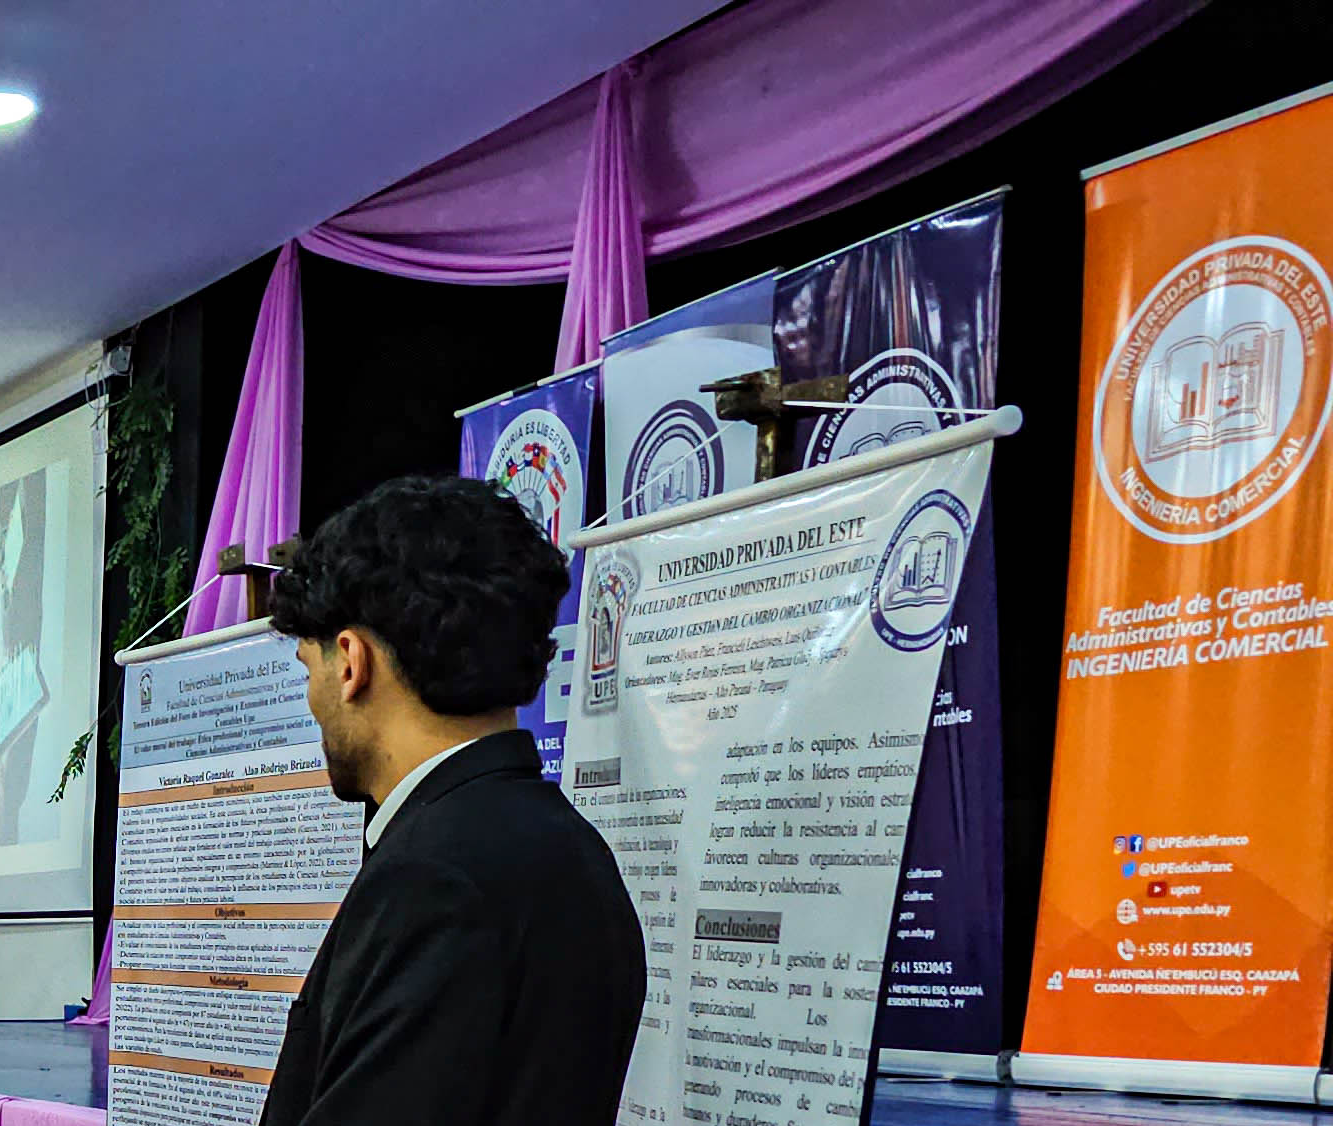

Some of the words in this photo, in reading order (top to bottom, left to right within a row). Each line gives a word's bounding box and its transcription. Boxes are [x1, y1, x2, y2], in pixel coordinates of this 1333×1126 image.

[1115, 270, 1200, 380] UNIVERSIDAD
[1204, 252, 1274, 276] PRIVADA
[1274, 260, 1304, 290] DEL
[1300, 283, 1328, 332] ESTE
[866, 364, 947, 409] ADMINISTRATIVAS
[526, 421, 535, 435] ES
[536, 421, 571, 466] LIBERTAD
[1120, 466, 1200, 525] INGENIERÍA
[1205, 434, 1306, 523] COMERCIAL
[658, 547, 734, 583] UNIVERSIDAD
[737, 534, 794, 564] PRIVADA
[797, 526, 823, 550] DEL
[829, 516, 866, 543] ESTE
[632, 596, 675, 617] FACULTAD
[676, 594, 688, 609] DE
[688, 586, 728, 608] CIENCIAS
[729, 569, 809, 600] ADMINISTRATIVAS
[810, 568, 817, 582] Y
[818, 554, 877, 580] CONTABLES
[1098, 597, 1181, 628] Facultad
[1185, 593, 1211, 615] de
[1216, 580, 1304, 610] Ciencias
[722, 617, 739, 633] DEL
[741, 606, 779, 629] CAMBIO
[1066, 618, 1212, 653] Administrativas
[1215, 616, 1227, 638] y
[1233, 597, 1333, 629] Contables
[1066, 636, 1190, 680] INGENIERÍA
[1195, 625, 1329, 664] COMERCIAL
[179, 675, 223, 694] Universidad
[225, 669, 254, 684] Privada
[256, 663, 270, 677] del
[271, 661, 290, 674] Este
[594, 680, 617, 698] UPE
[933, 707, 973, 727] ntables
[789, 737, 804, 753] los
[811, 735, 859, 757] equipos.
[183, 771, 204, 786] Raquel
[205, 768, 235, 783] Gonzalez
[244, 765, 259, 776] Alan
[260, 762, 289, 776] Rodrigo
[290, 757, 322, 771] Brizuela
[764, 769, 781, 786] que
[788, 765, 804, 781] los
[812, 763, 850, 781] líderes
[766, 792, 822, 810] emocional
[826, 795, 834, 812] y
[839, 791, 875, 809] visión
[740, 821, 776, 838] reducir
[783, 821, 793, 837] la
[799, 820, 858, 838] resistencia
[865, 820, 877, 837] al
[704, 848, 749, 866] favorecen
[757, 849, 799, 866] culturas
[809, 848, 900, 870] organizacionales
[699, 875, 758, 893] innovadoras
[758, 879, 766, 896] y
[768, 876, 842, 896] colaborativas.
[1142, 903, 1231, 918] www.upe.edu.py
[695, 914, 781, 940] Conclusiones
[692, 944, 701, 961] El
[706, 944, 753, 968] liderazgo
[757, 951, 766, 969] y
[771, 949, 781, 966] la
[785, 950, 826, 971] gestión
[833, 952, 850, 970] del
[1138, 941, 1170, 958] +595
[1172, 942, 1188, 957] 61
[1191, 941, 1253, 958] 552304/5
[901, 961, 910, 974] 61
[913, 961, 952, 974] 552304/5
[1109, 968, 1155, 980] AVENIDA
[1246, 967, 1300, 982] CAAZAPÁ
[726, 975, 779, 994] esenciales
[787, 982, 812, 999] para
[823, 981, 833, 998] la
[1093, 983, 1133, 995] CIUDAD
[1134, 983, 1197, 996] PRESIDENTE
[1198, 984, 1245, 997] FRANCO
[1253, 985, 1268, 997] PY
[805, 1007, 828, 1026] Los
[777, 1033, 827, 1056] impulsan
[832, 1040, 842, 1057] la
[743, 1060, 750, 1078] y
[754, 1059, 765, 1076] el
[767, 1063, 836, 1086] compromiso
[838, 1071, 856, 1089] del
[734, 1088, 781, 1106] procesos
[797, 1093, 811, 1111] de
